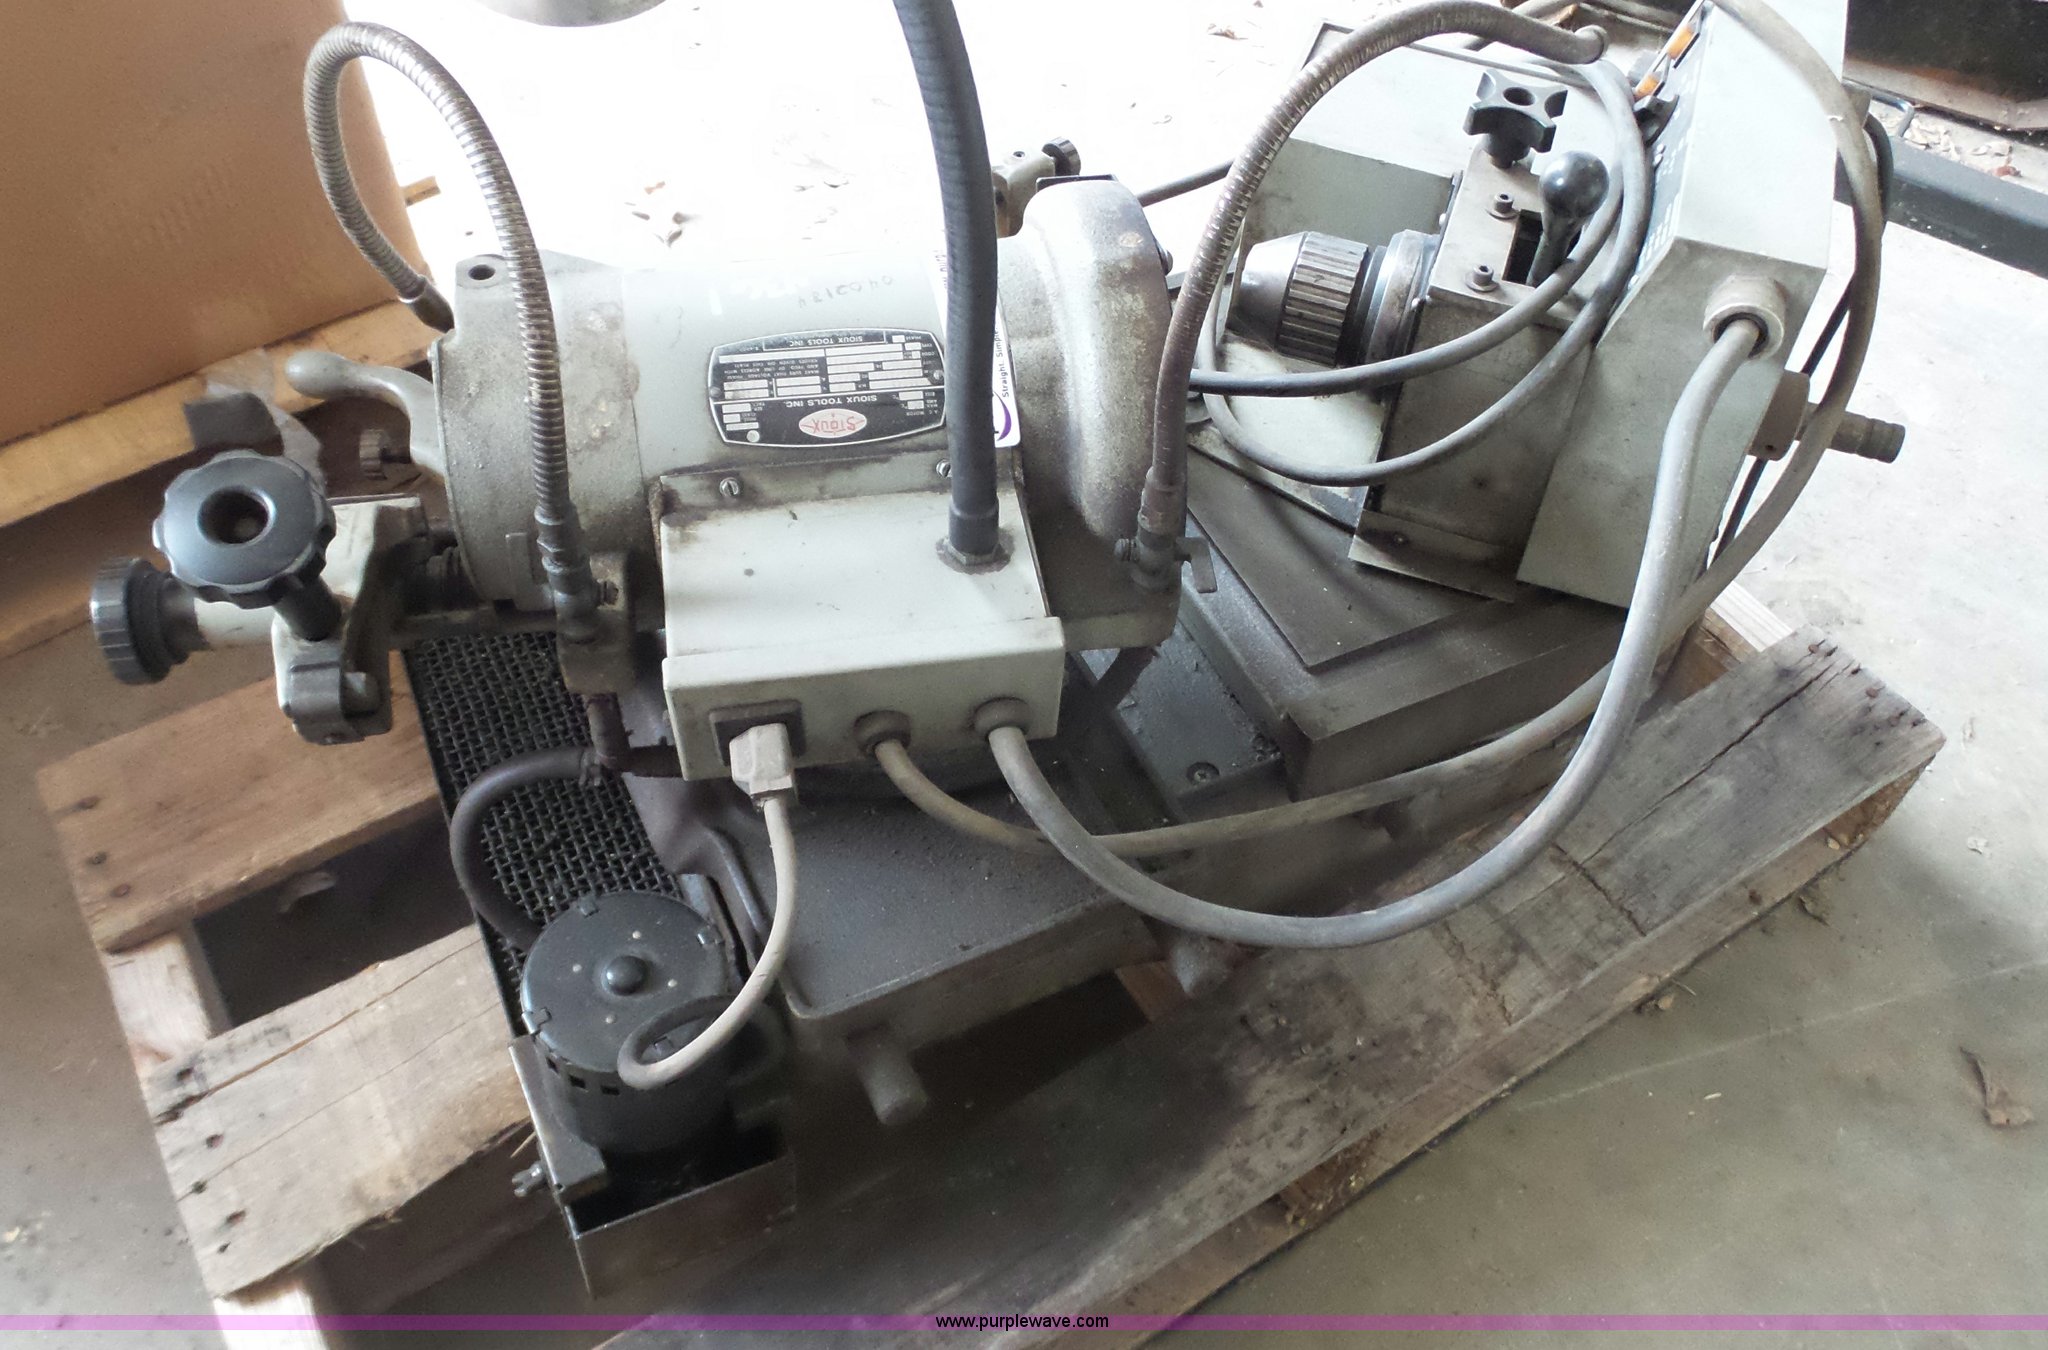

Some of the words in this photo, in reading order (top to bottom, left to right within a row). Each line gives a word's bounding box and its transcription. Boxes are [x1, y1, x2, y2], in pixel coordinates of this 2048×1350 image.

[838, 335, 863, 343] SIOUX
[783, 400, 804, 408] INC.
[807, 397, 843, 407] TOOLS
[846, 394, 878, 404] SIOUX
[811, 416, 856, 434] SIOUX
